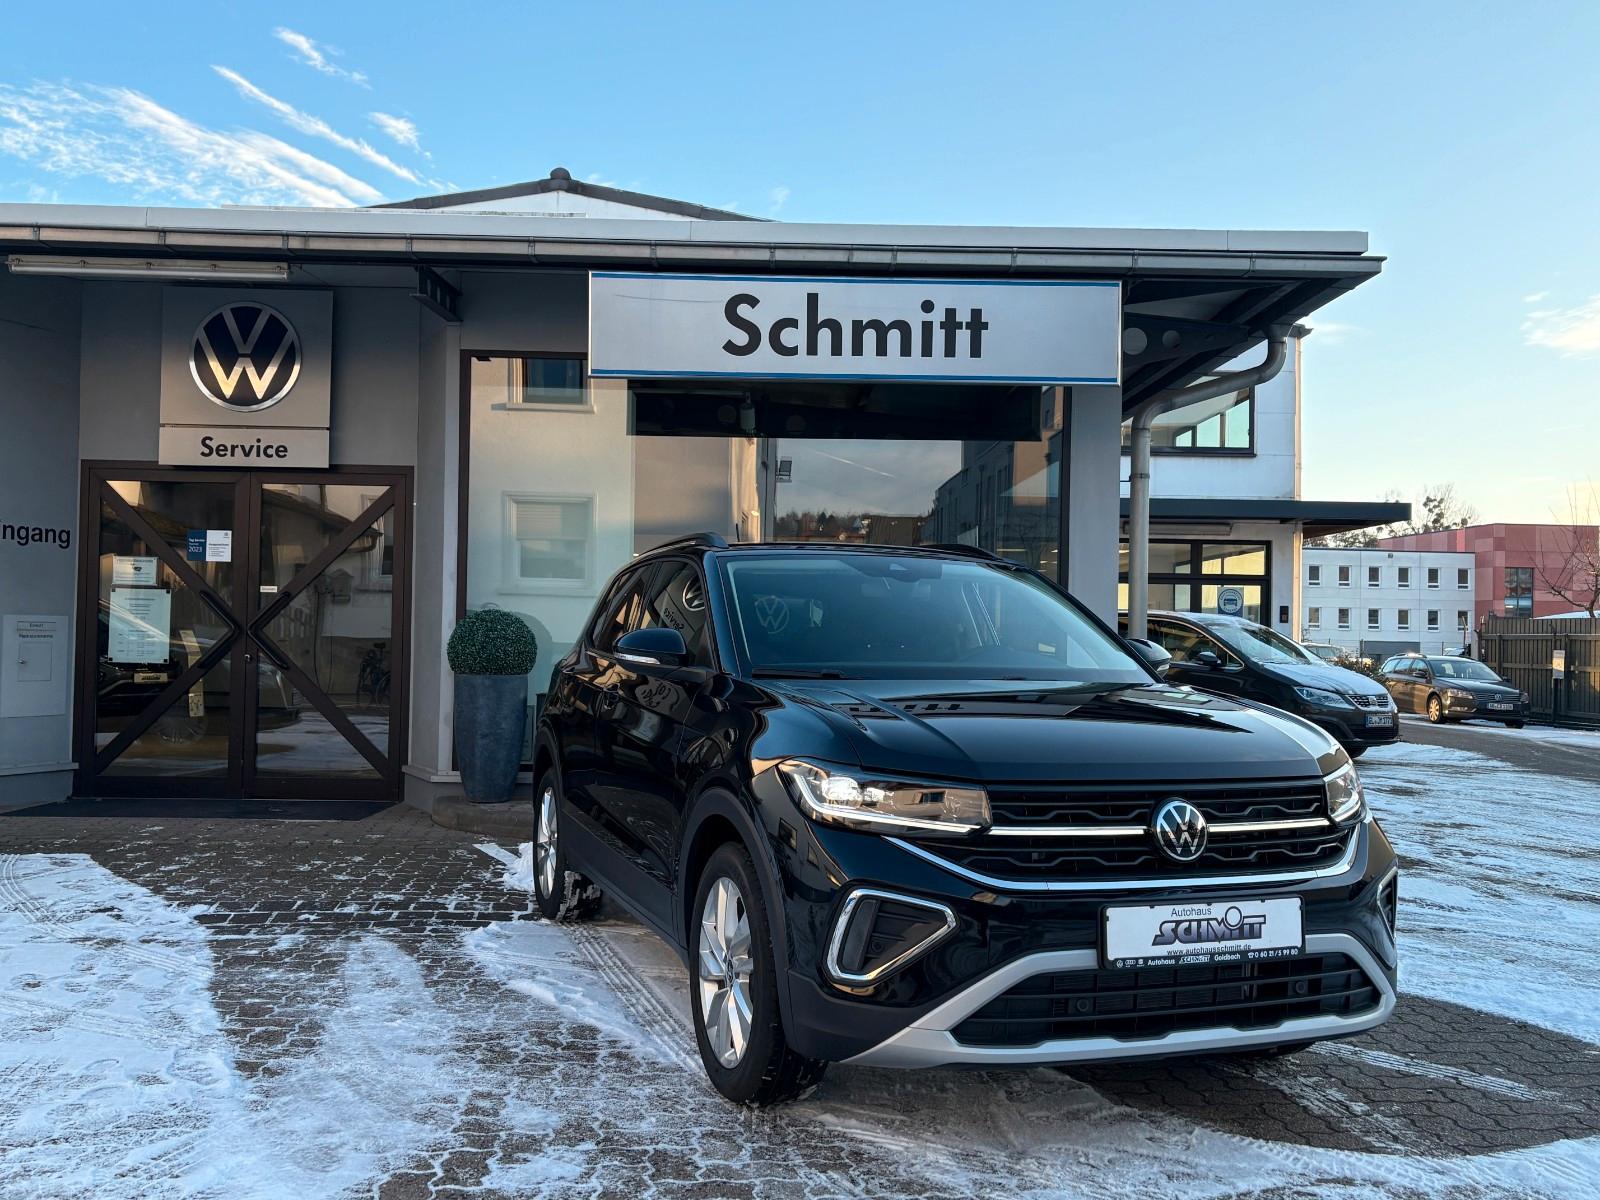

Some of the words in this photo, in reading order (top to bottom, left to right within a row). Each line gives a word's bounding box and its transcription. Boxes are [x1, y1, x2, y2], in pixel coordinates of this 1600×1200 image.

[722, 293, 989, 358] Schmitt
[200, 436, 288, 458] Service
[1, 524, 71, 549] ngang
[1170, 907, 1212, 918] Autohaus
[1167, 944, 1252, 956] www.autohausschmitt.de
[1214, 952, 1240, 962] Goldbach
